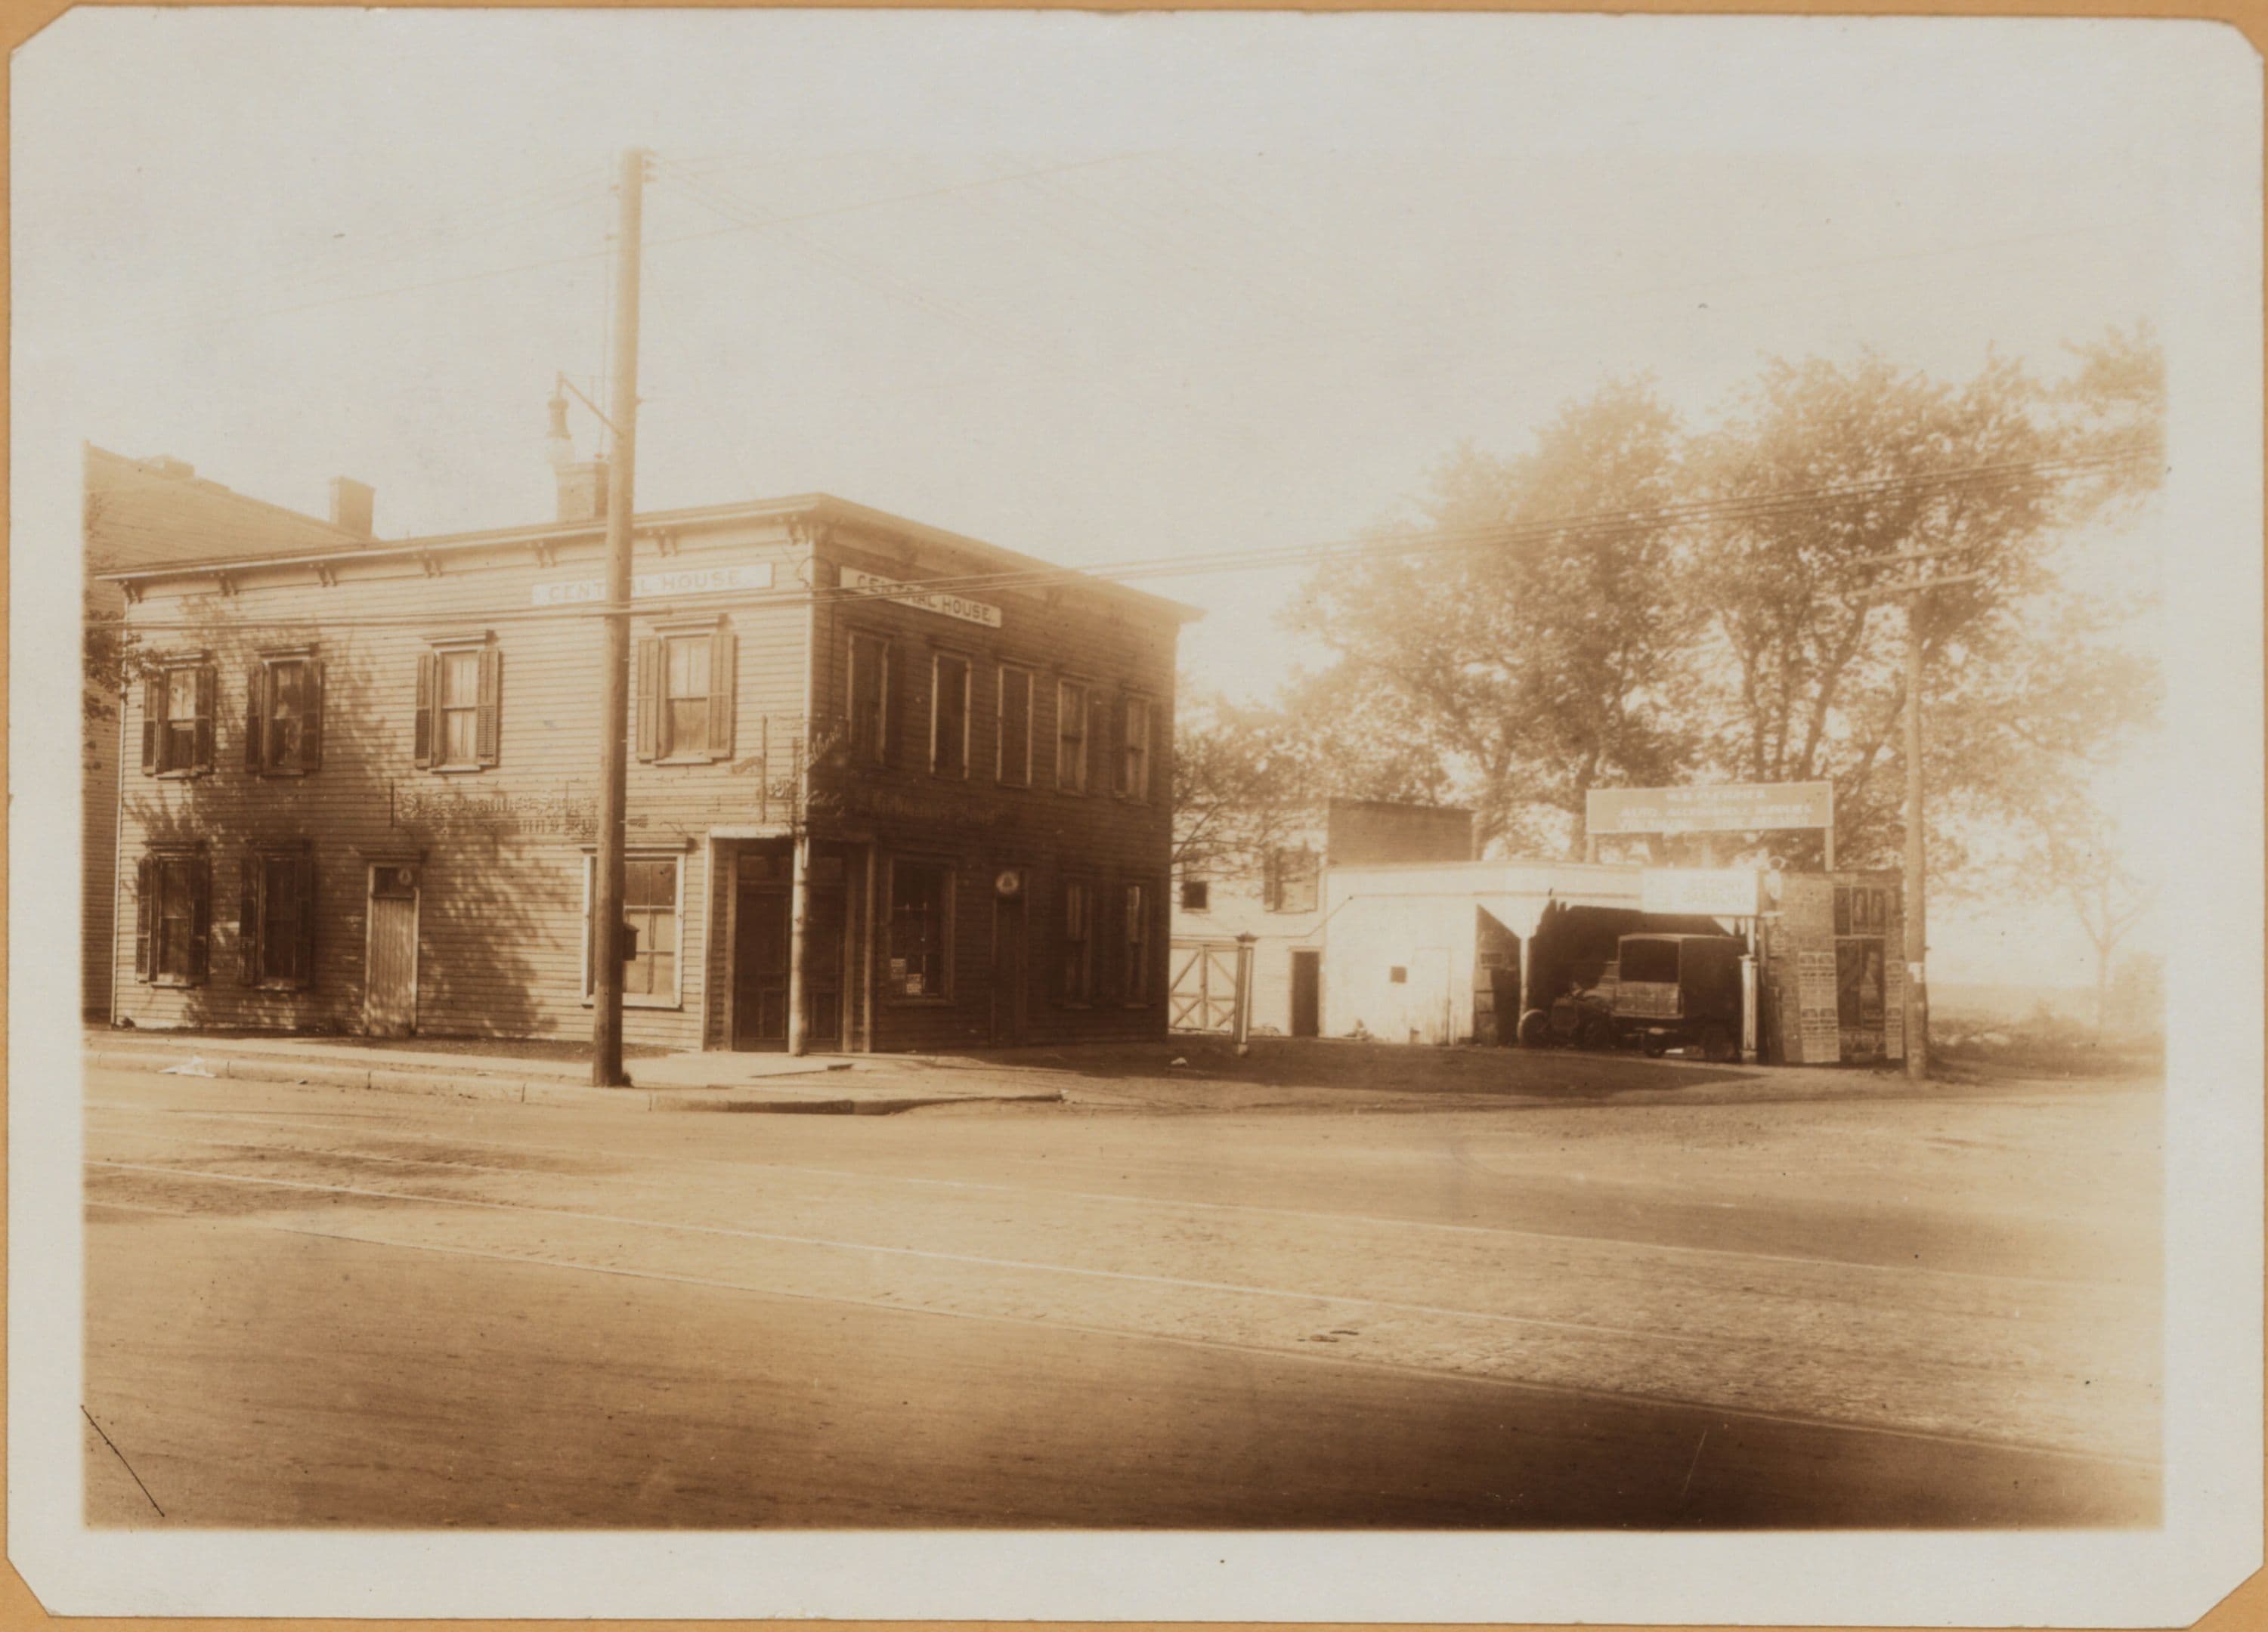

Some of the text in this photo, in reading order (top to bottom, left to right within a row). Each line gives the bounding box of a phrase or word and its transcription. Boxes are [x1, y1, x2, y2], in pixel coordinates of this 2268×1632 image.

[549, 570, 741, 601] CENTL HOUSE
[942, 595, 992, 623] HOUSE
